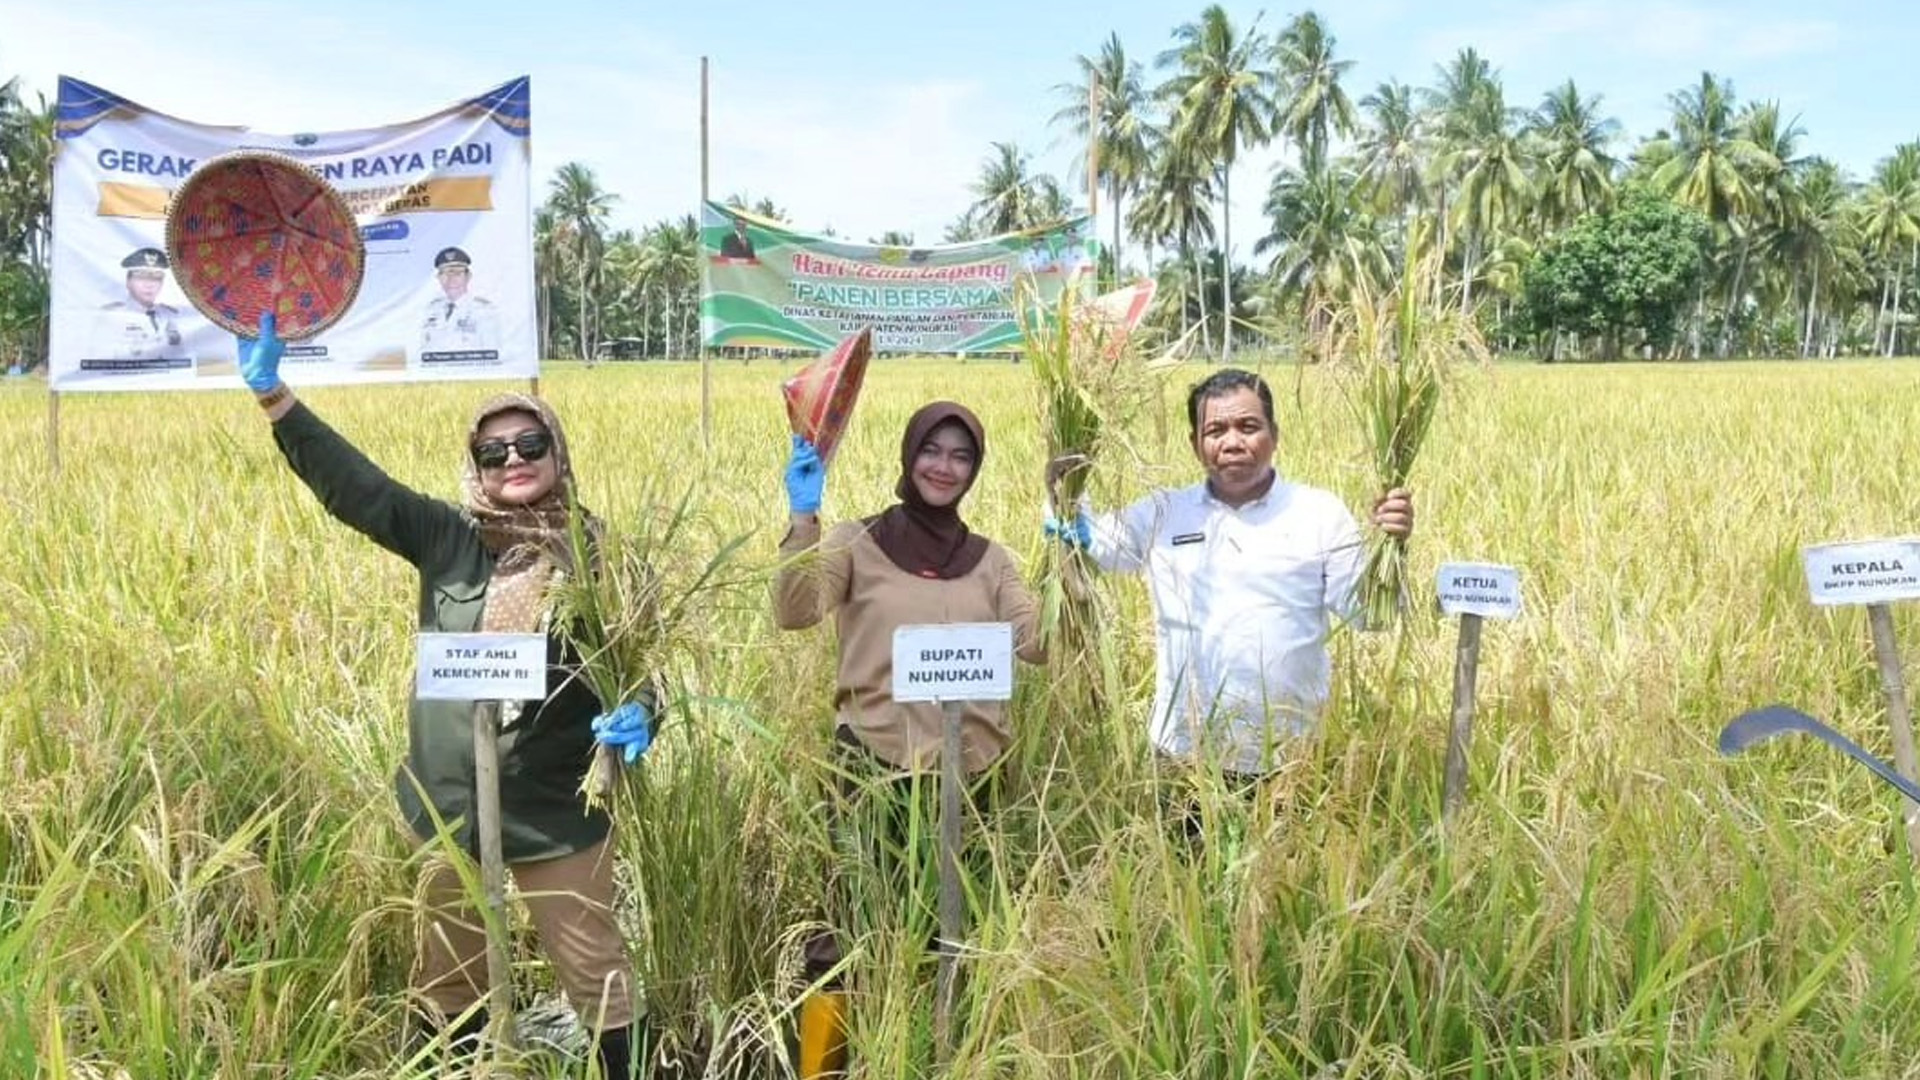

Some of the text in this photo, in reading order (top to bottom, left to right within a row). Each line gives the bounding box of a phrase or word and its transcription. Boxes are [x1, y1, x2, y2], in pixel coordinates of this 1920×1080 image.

[97, 148, 197, 178] GERAK
[351, 152, 425, 179] RAYA
[432, 142, 493, 168] PADI
[342, 182, 429, 202] ERCEPATAN
[792, 253, 845, 276] Hari
[919, 263, 1007, 283] Lapang
[783, 305, 816, 318] DINAS
[1831, 559, 1904, 575] KEPALA
[1452, 576, 1498, 589] KETUA
[1857, 576, 1918, 588] NUNUKAN
[1464, 594, 1512, 605] NUNUKAN
[445, 648, 518, 660] STAF AHLI
[920, 648, 983, 662] BUPATI
[431, 667, 529, 679] KEMENTAN RI
[908, 667, 994, 683] NUNUKAN
